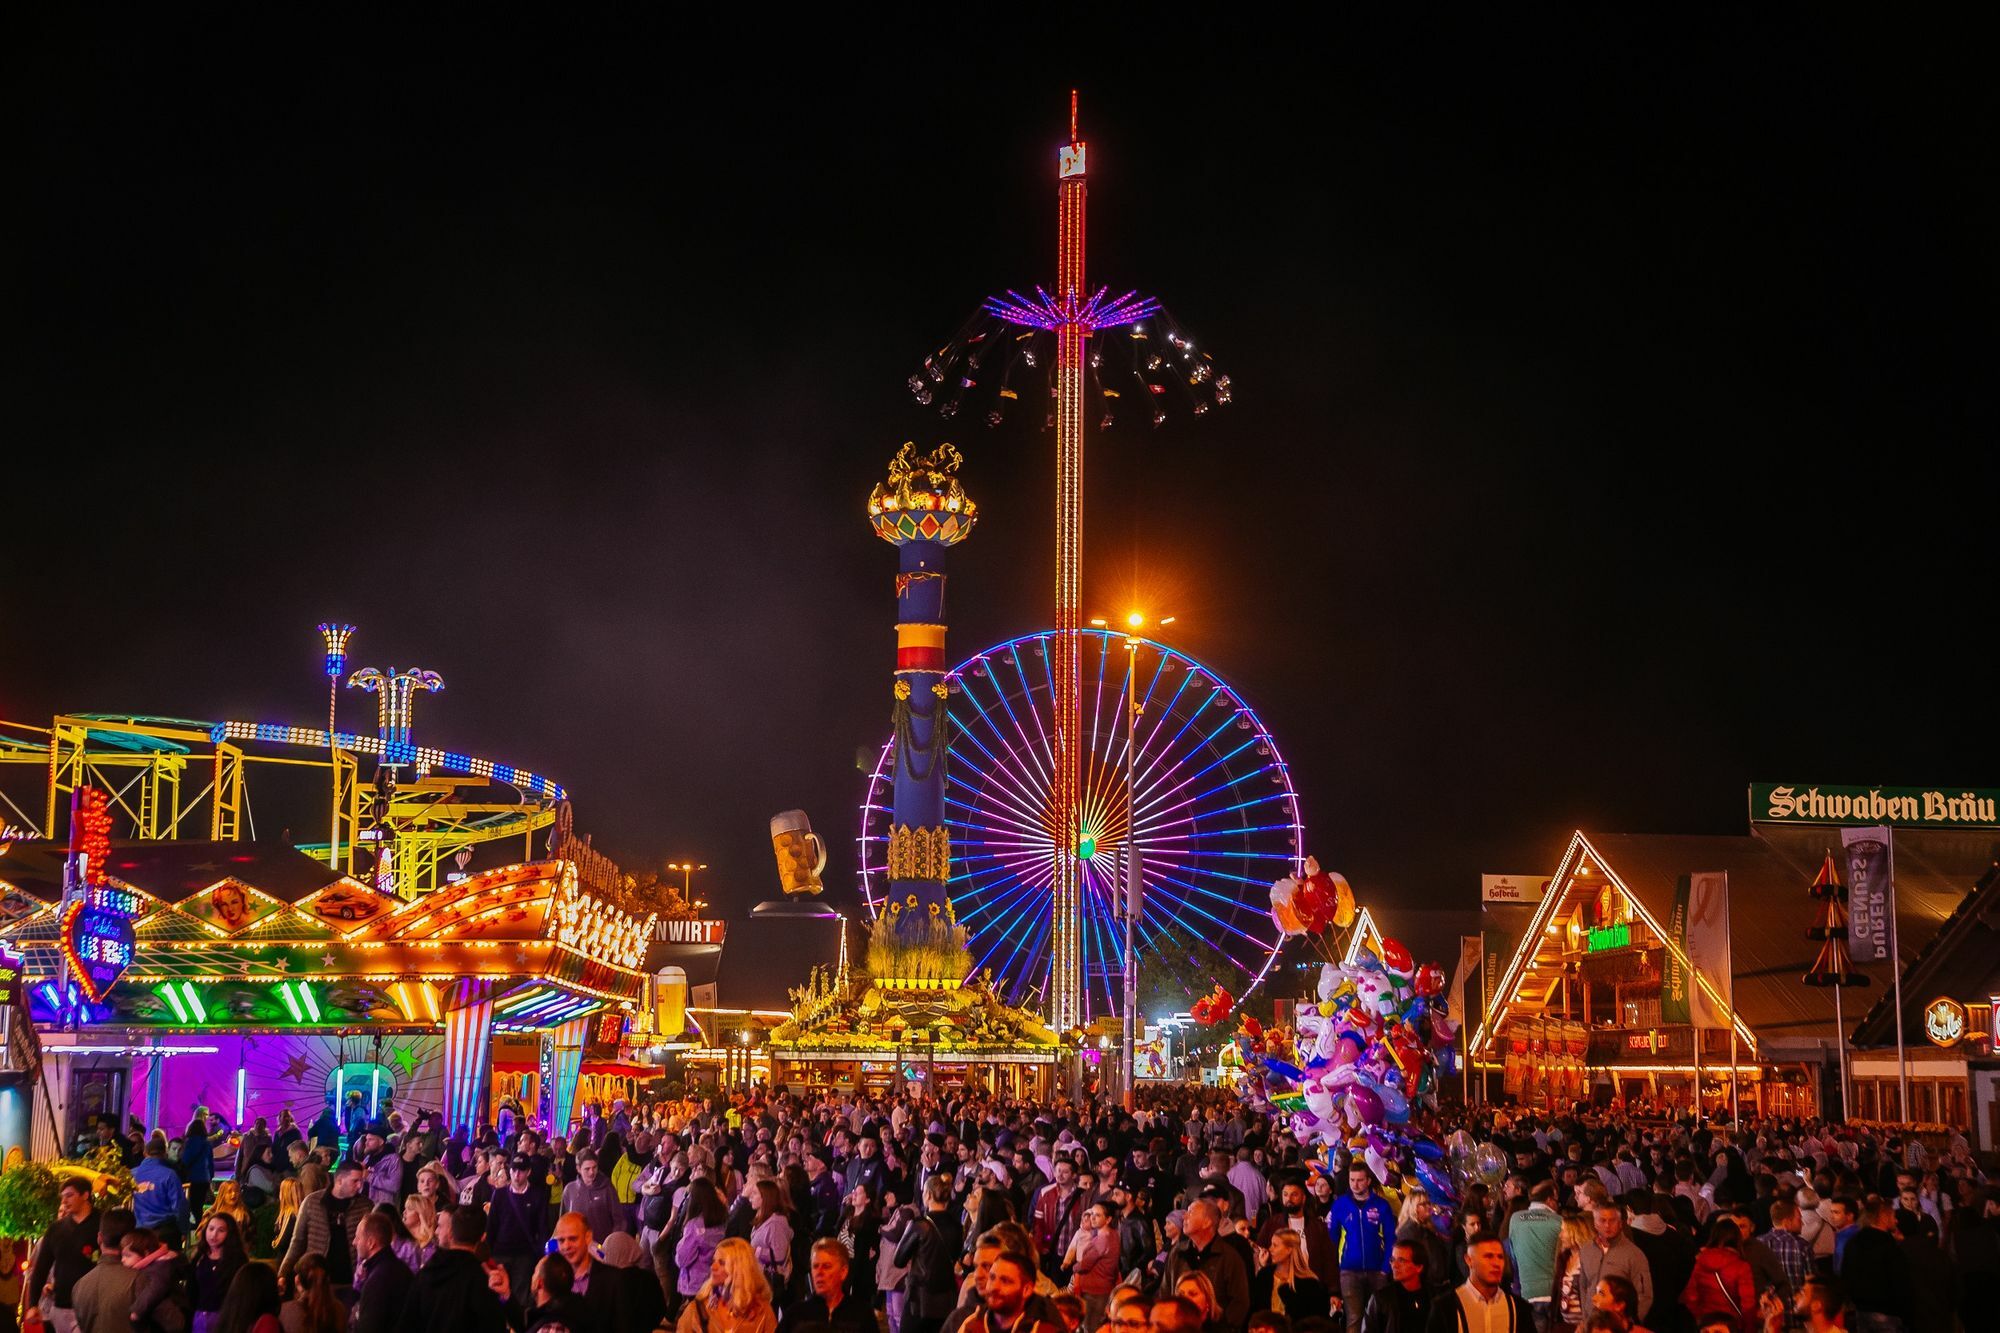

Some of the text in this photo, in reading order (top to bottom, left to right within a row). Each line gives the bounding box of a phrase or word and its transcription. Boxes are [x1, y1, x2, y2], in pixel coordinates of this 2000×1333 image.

[1768, 785, 1997, 822] Schwaben Bräu
[655, 920, 714, 942] NWIRT
